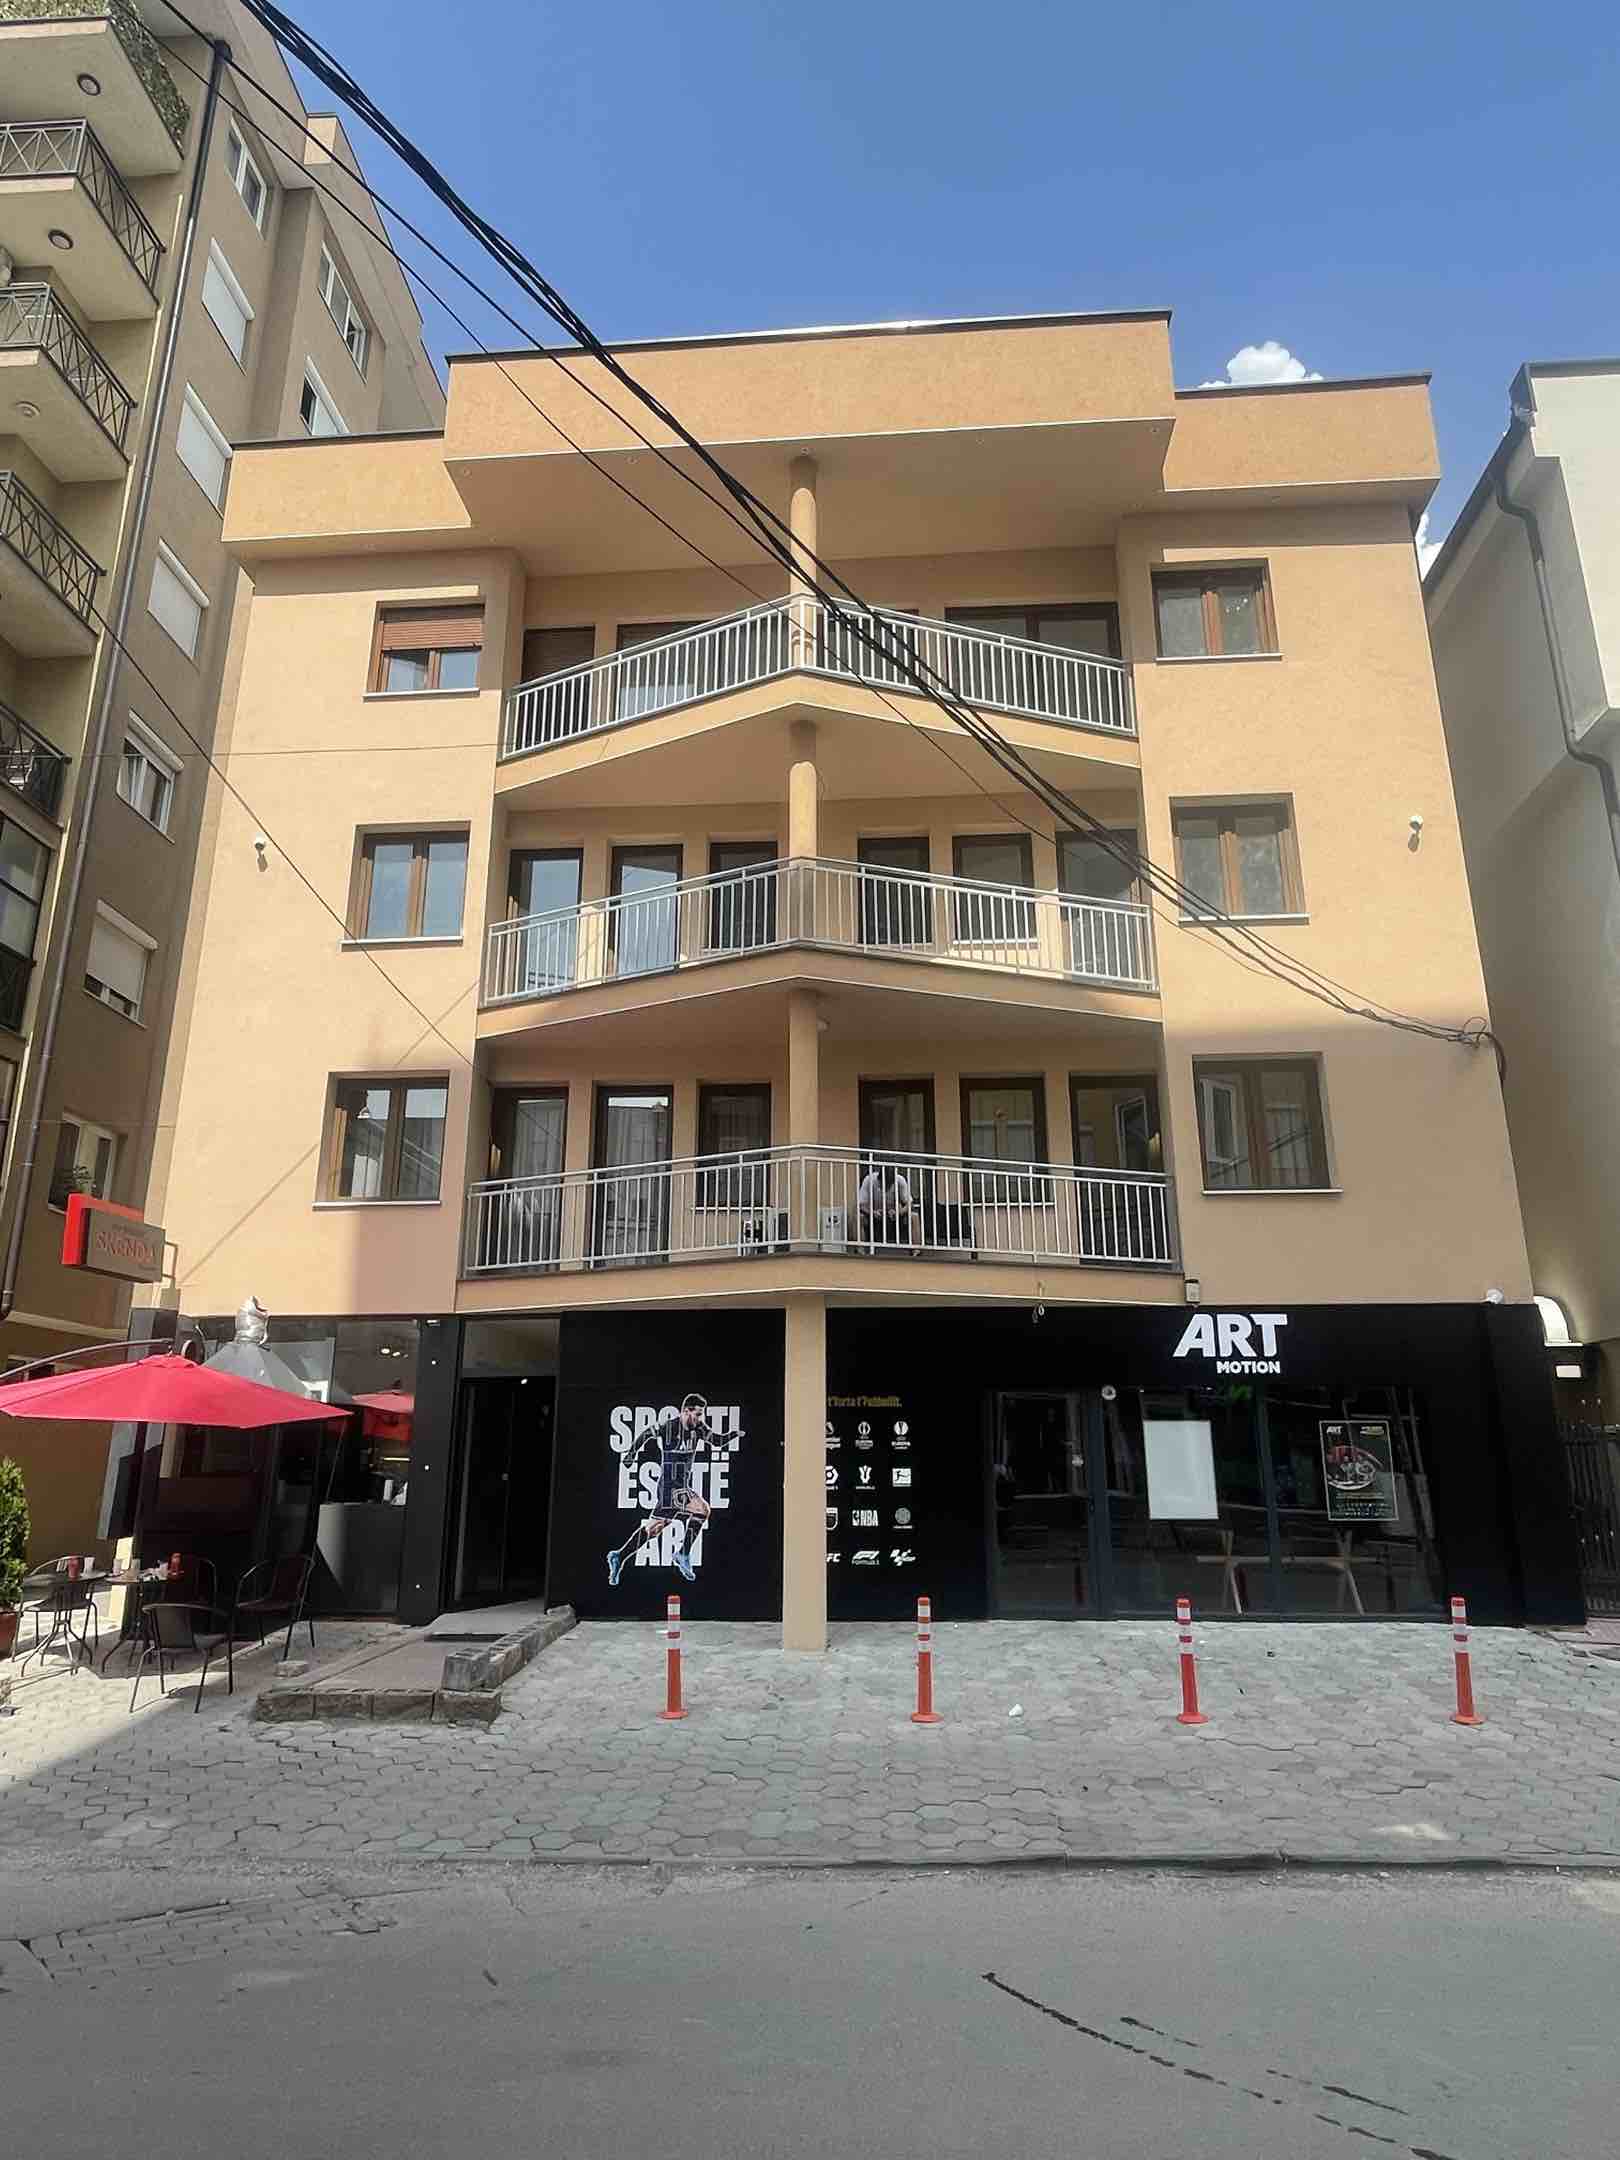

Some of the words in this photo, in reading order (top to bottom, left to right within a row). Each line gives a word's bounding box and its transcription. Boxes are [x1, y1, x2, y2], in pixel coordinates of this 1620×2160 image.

[1172, 1313, 1288, 1357] ART
[1216, 1360, 1281, 1374] MOTION
[609, 1406, 741, 1453] SPTI
[617, 1452, 730, 1509] ËSTË
[861, 1509, 879, 1527] NBA
[826, 1552, 841, 1563] FC
